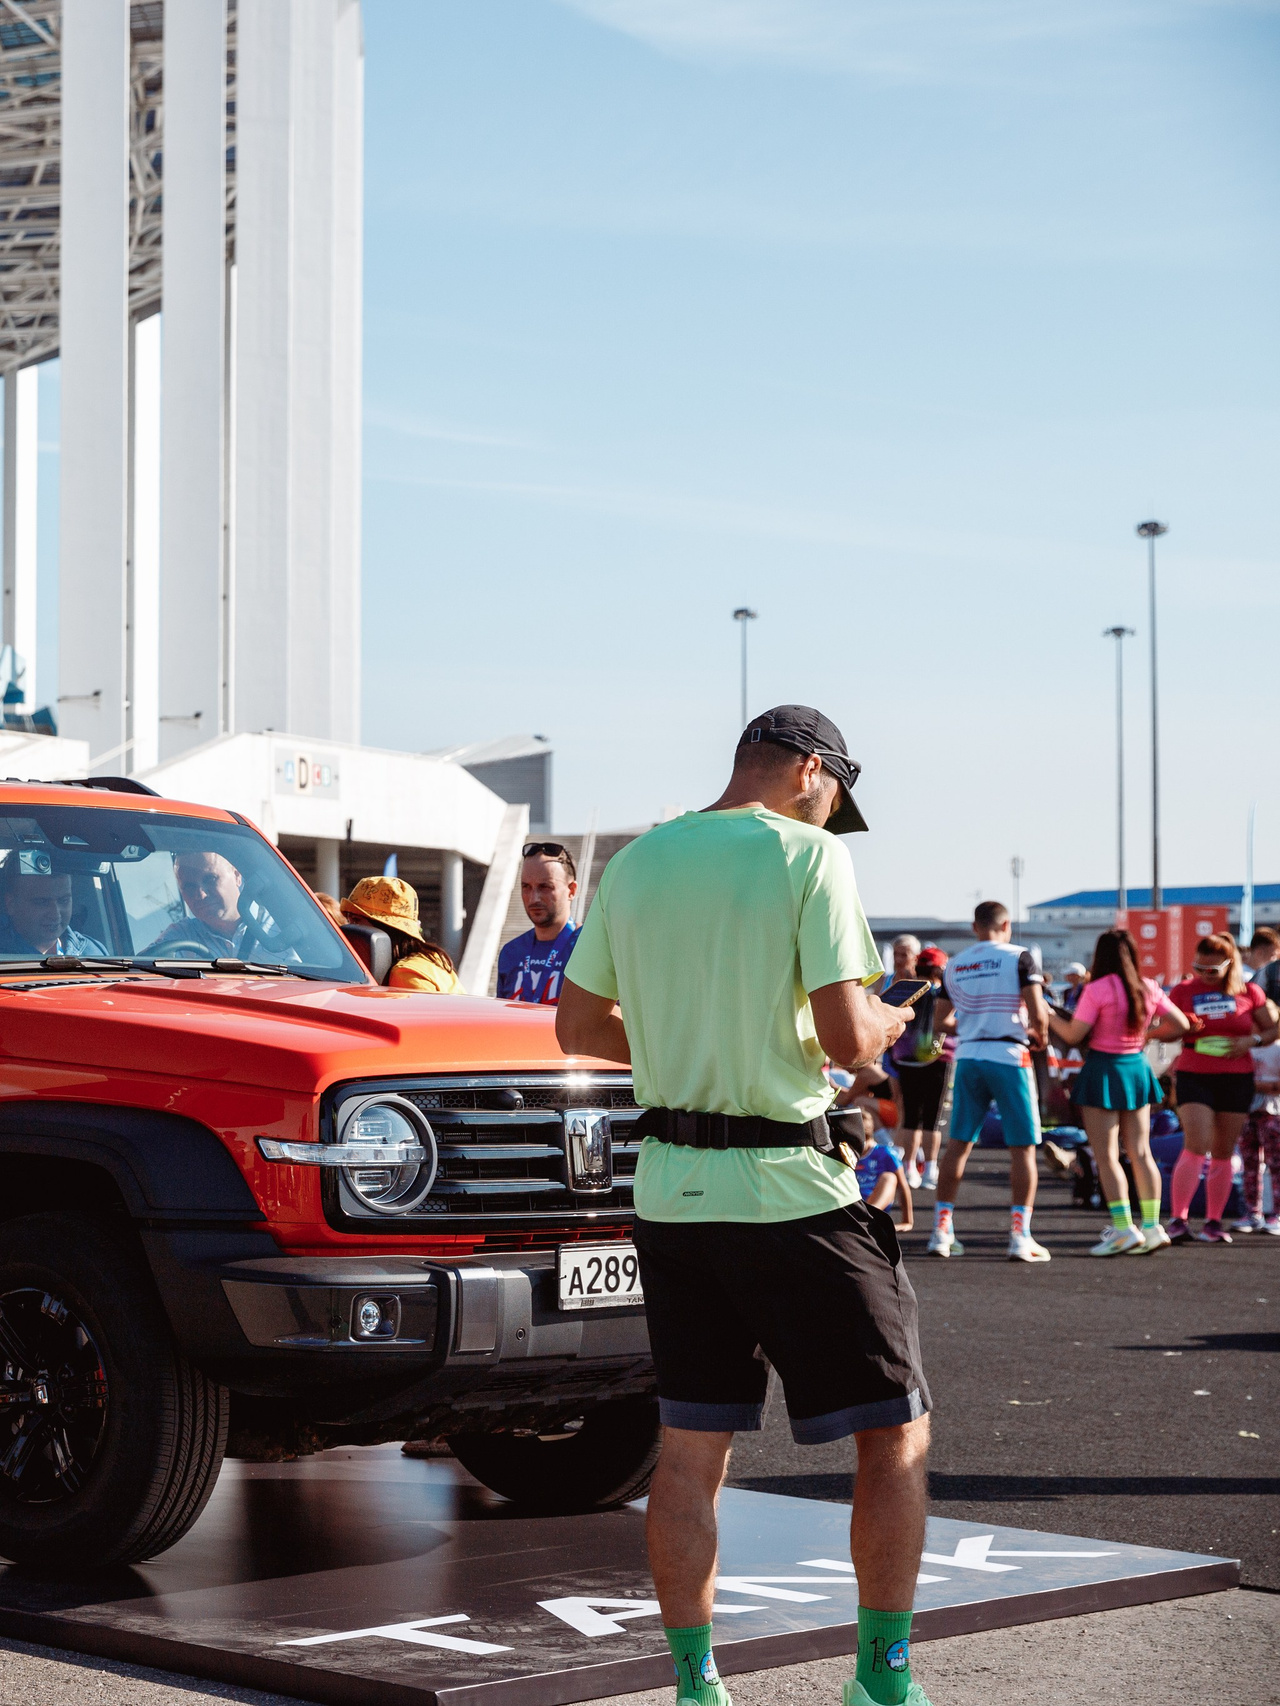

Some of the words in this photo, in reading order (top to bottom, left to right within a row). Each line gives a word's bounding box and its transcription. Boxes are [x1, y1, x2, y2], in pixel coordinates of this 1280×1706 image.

[568, 1254, 638, 1296] A289
[626, 1296, 644, 1304] TAN
[275, 1533, 1121, 1654] TANK
